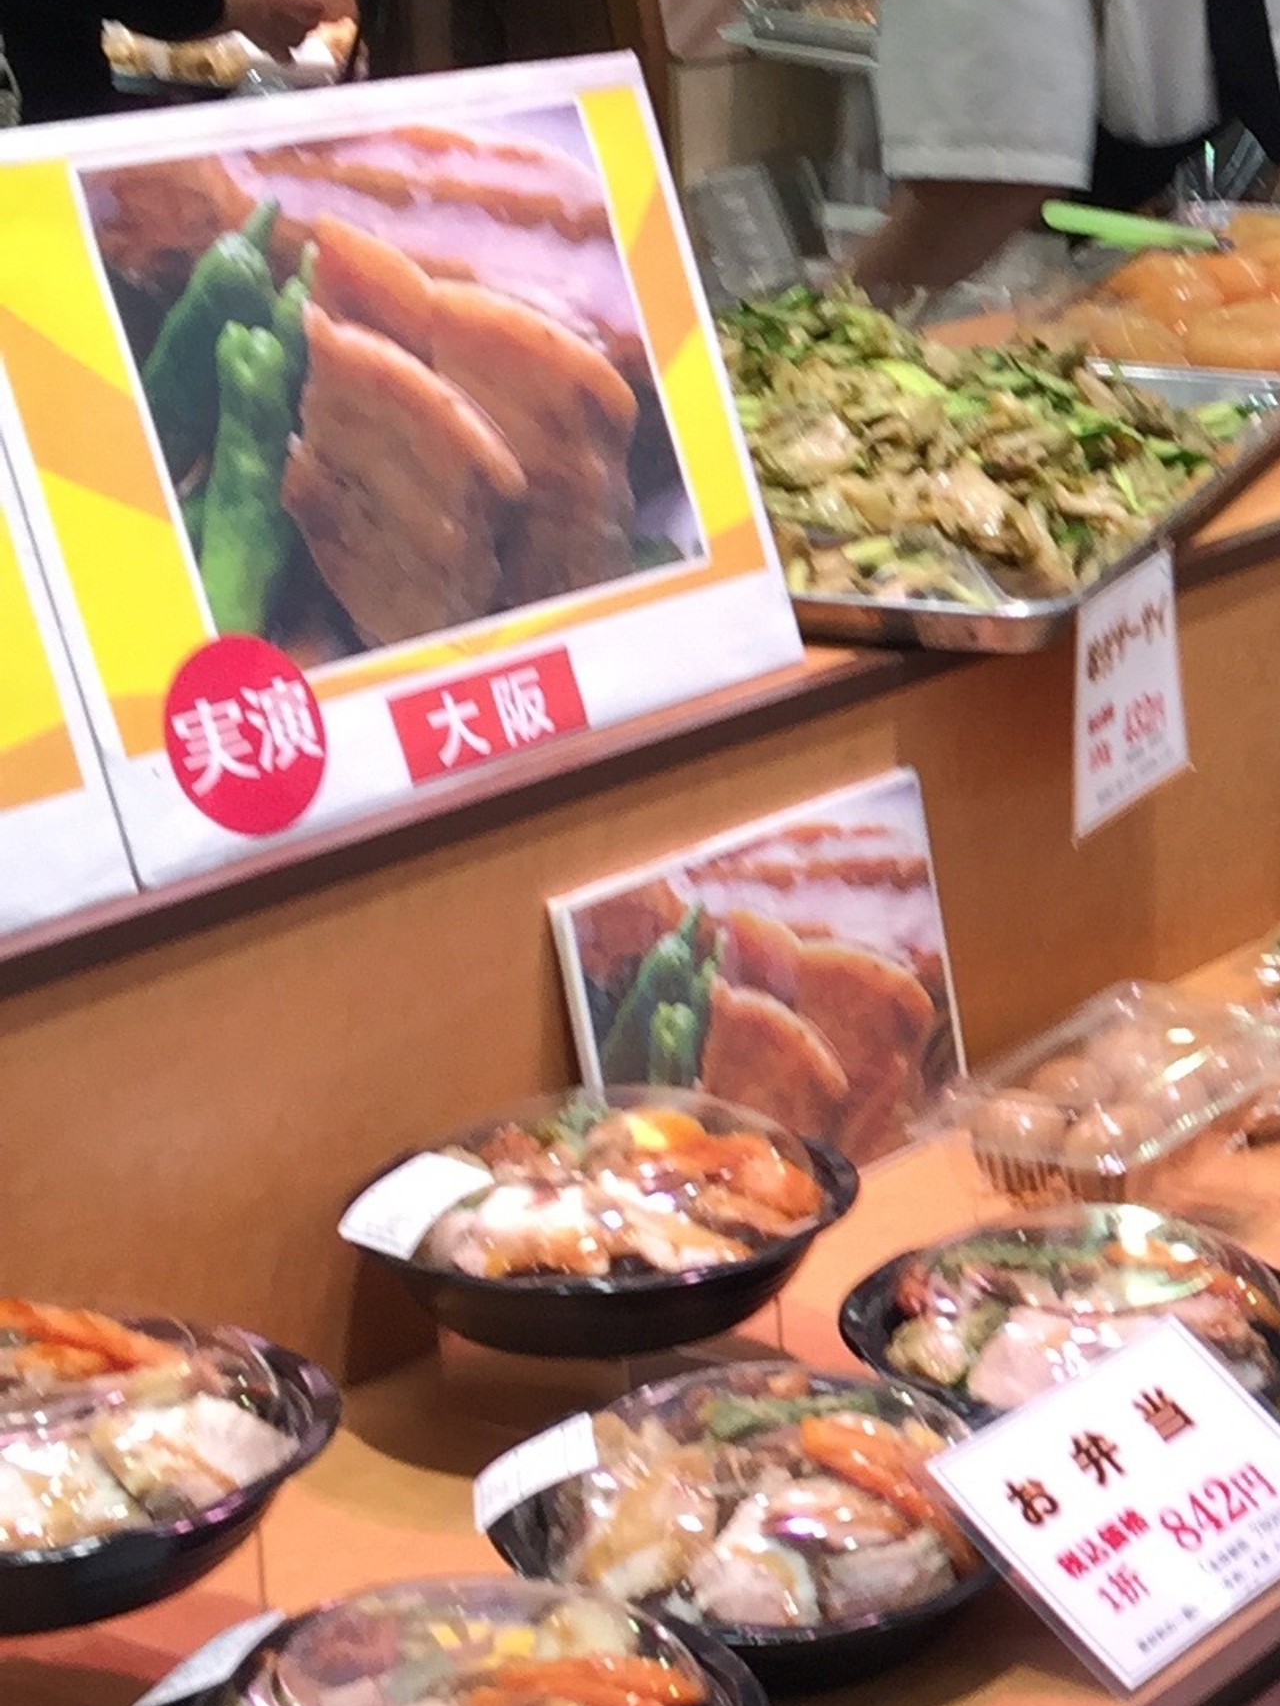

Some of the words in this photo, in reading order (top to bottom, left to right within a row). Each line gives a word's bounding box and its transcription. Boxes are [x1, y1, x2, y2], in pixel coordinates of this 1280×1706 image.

[173, 678, 324, 798] 実演
[427, 665, 556, 767] 大阪
[1005, 1384, 1199, 1529] お弁当
[1157, 1462, 1280, 1556] 842円
